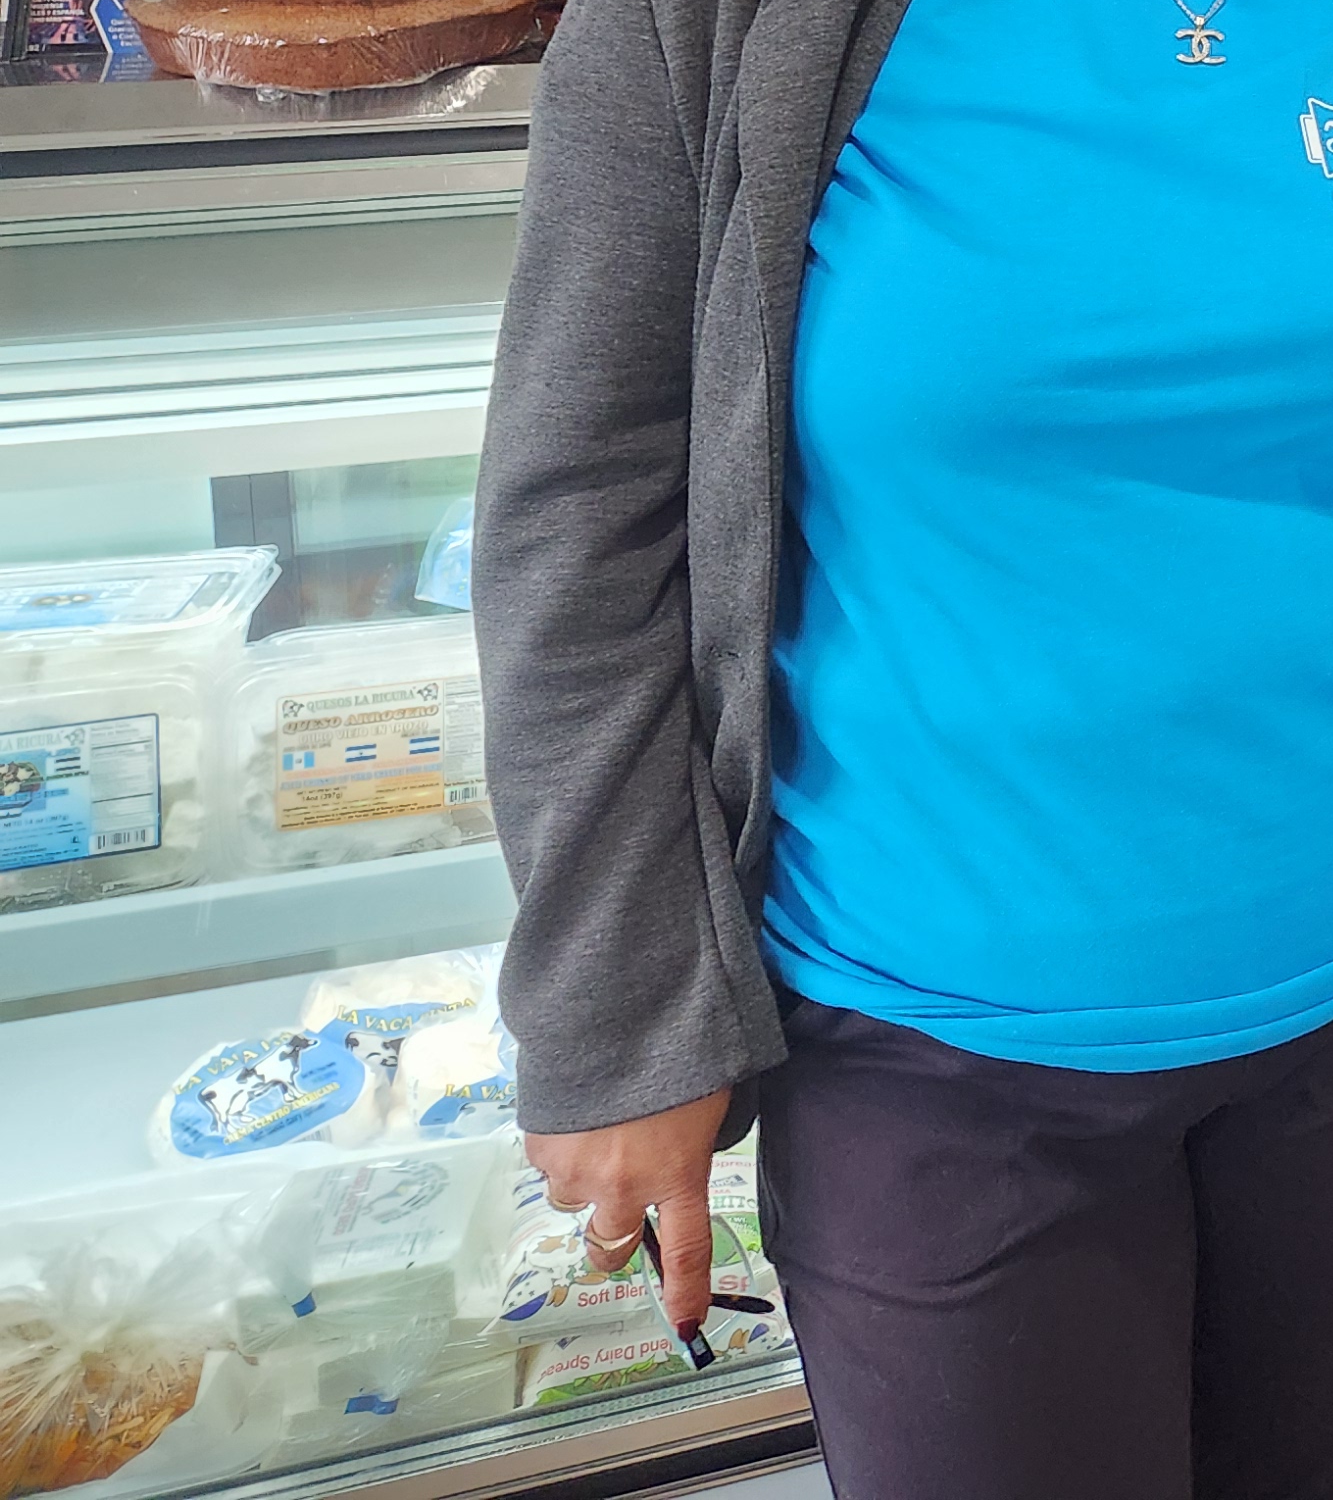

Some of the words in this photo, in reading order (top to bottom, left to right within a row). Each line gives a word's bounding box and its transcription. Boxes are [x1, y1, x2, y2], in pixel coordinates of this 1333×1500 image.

[354, 694, 371, 706] LA
[372, 689, 415, 705] RICURA
[337, 1004, 361, 1026] LA
[365, 1015, 414, 1032] VACA
[446, 1083, 472, 1100] LA
[578, 1289, 610, 1308] Soft
[594, 1345, 636, 1365] Dairy
